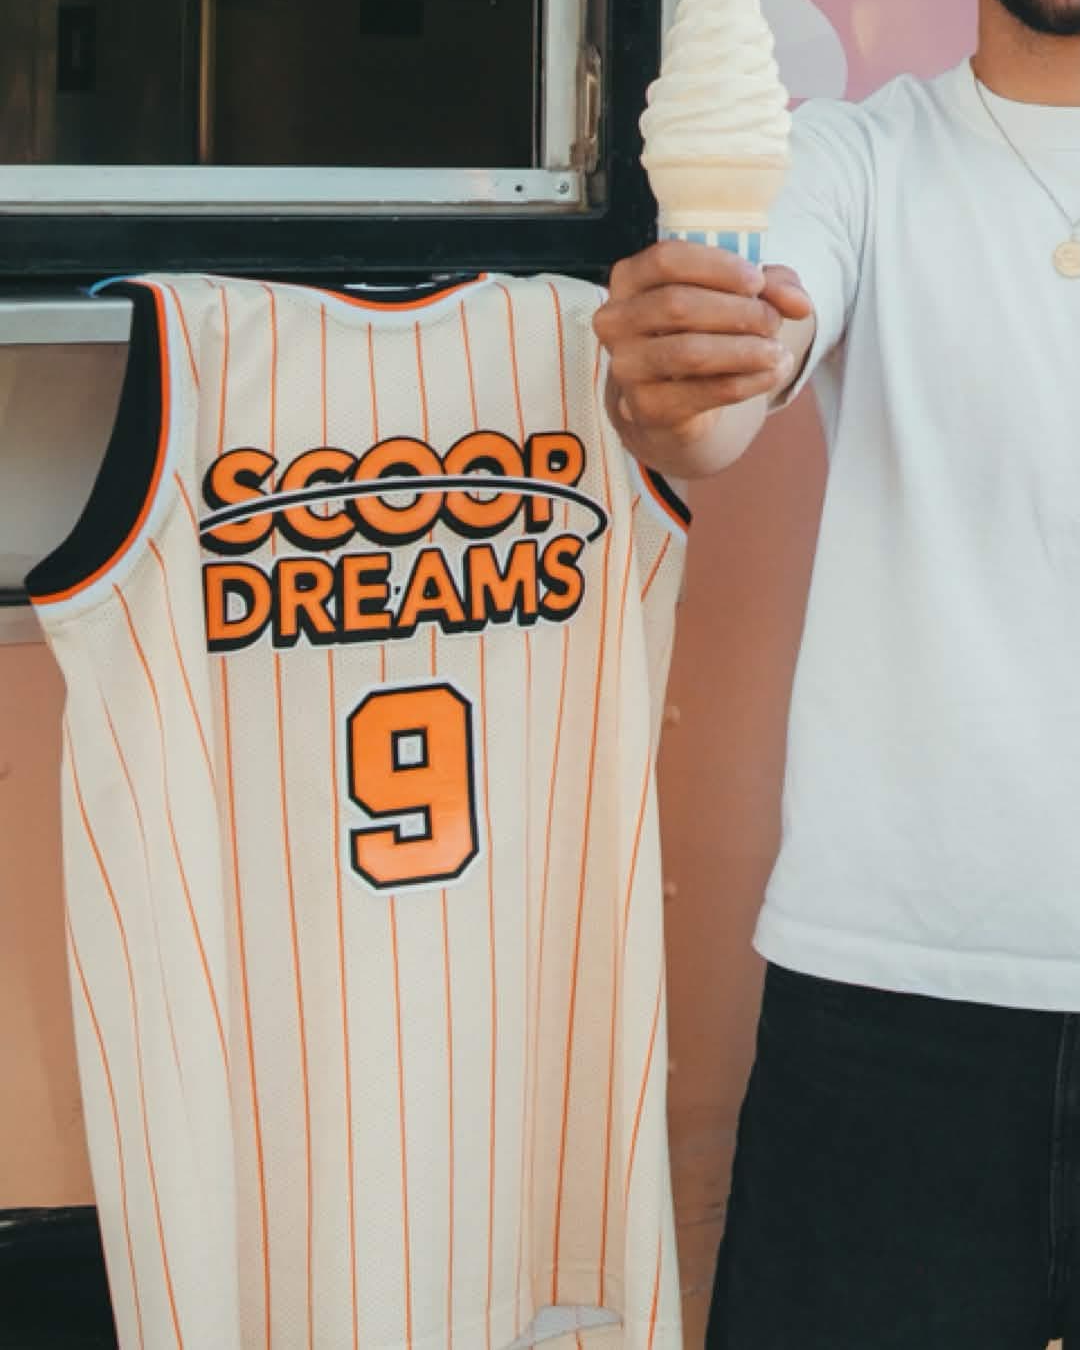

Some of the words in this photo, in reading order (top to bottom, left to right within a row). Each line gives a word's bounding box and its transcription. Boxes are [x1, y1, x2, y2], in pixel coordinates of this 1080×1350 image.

[199, 430, 586, 556] SCOOP
[202, 533, 586, 654] DREAMS
[346, 682, 480, 890] 9
